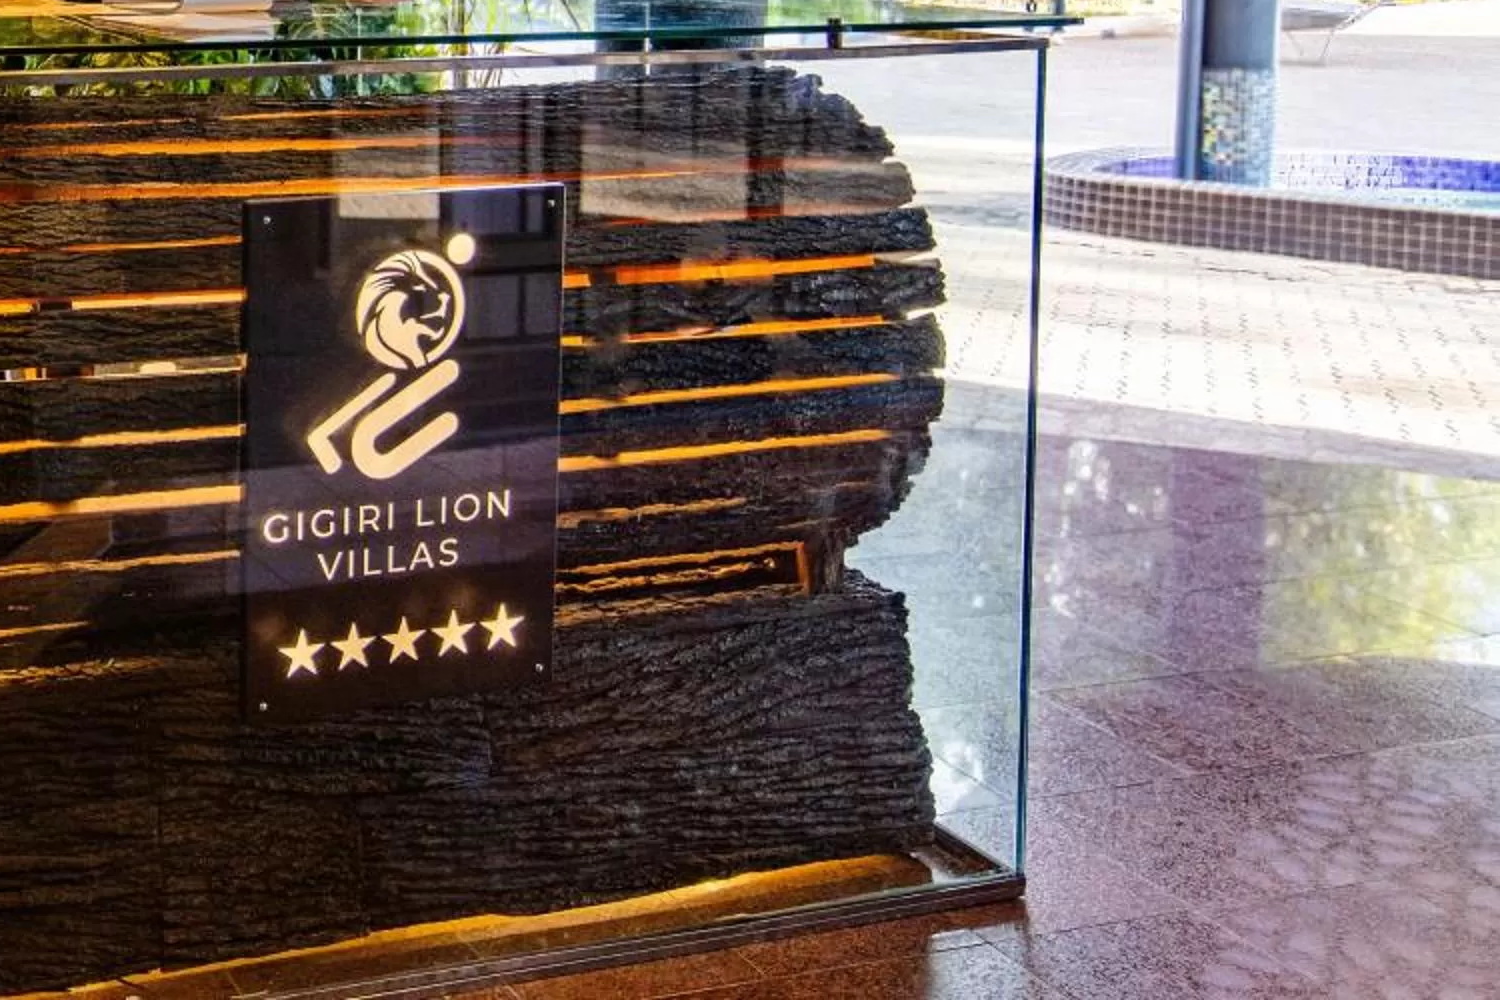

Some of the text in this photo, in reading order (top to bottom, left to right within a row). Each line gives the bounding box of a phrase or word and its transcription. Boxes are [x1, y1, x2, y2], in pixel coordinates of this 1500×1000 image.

[263, 489, 511, 544] GIGIRI LION
[317, 538, 460, 581] VILLAS
